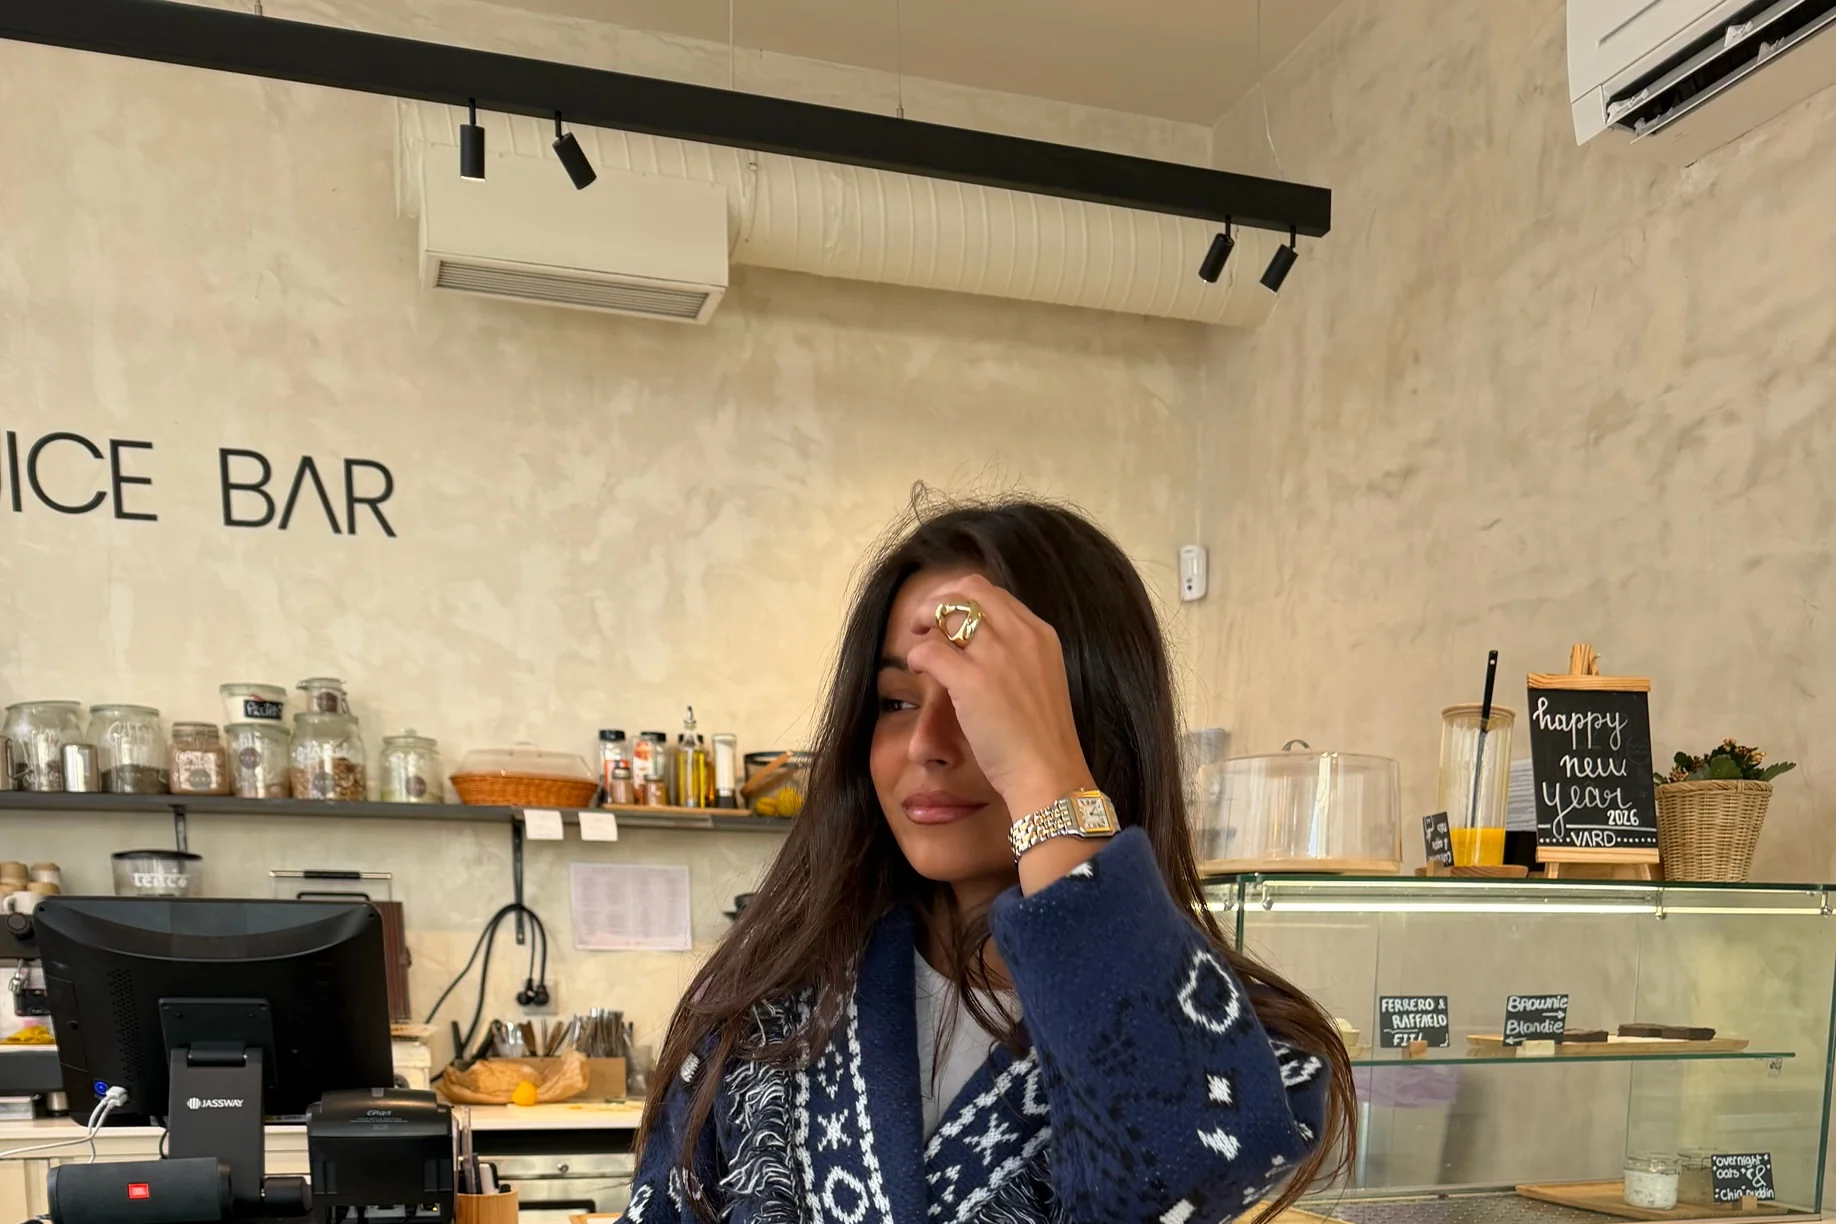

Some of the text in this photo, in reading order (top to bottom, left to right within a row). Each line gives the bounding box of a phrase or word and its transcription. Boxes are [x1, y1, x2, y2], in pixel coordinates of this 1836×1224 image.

[0, 430, 398, 538] ICE BAR
[1532, 696, 1629, 751] happy
[1559, 754, 1628, 779] new
[1606, 808, 1641, 827] 2026
[1570, 830, 1617, 848] VARD
[1381, 998, 1434, 1013] FERRERO
[1391, 1013, 1448, 1029] RAFFAELO
[1505, 1019, 1564, 1035] Blondie
[201, 1098, 245, 1108] JASSWAY
[1715, 1154, 1763, 1169] overnight
